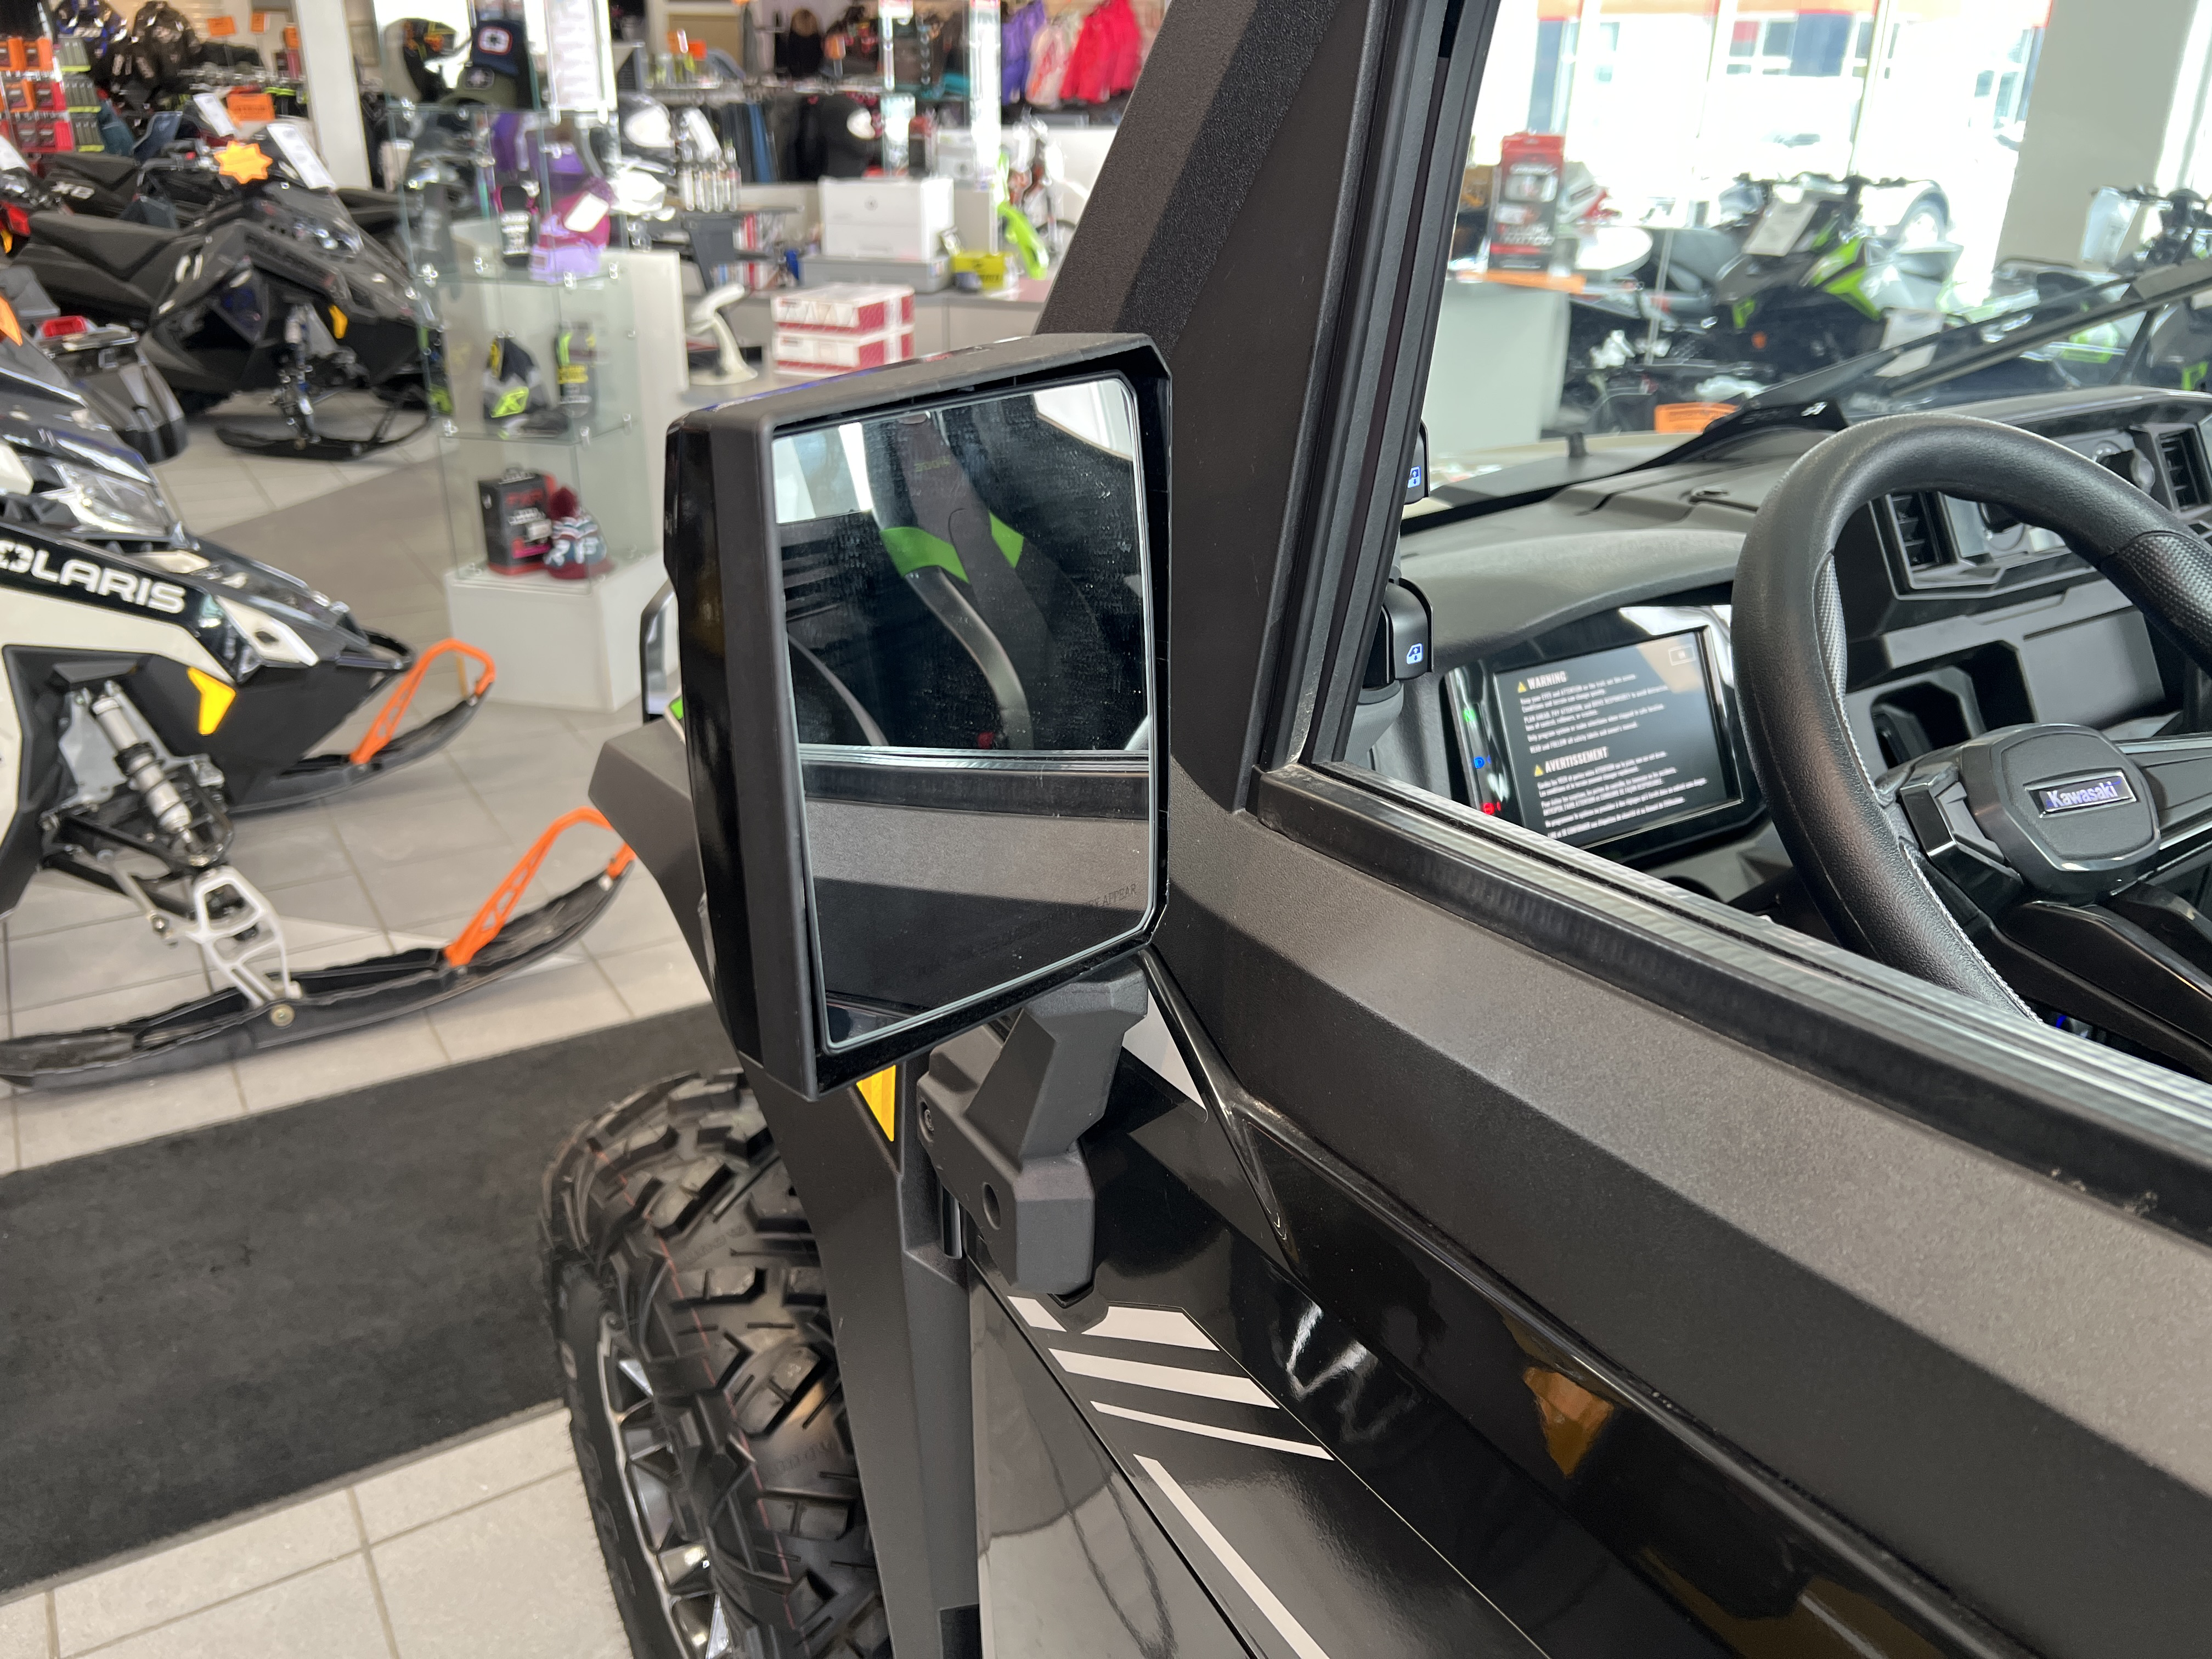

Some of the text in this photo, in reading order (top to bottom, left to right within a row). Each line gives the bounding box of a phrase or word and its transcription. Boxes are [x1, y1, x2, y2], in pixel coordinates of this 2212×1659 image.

[1527, 670, 1567, 690] WARNING
[1545, 746, 1609, 774] AVERTISSEMENT
[2047, 781, 2118, 808] Kawasaki
[1103, 883, 1137, 906] APPEAR
